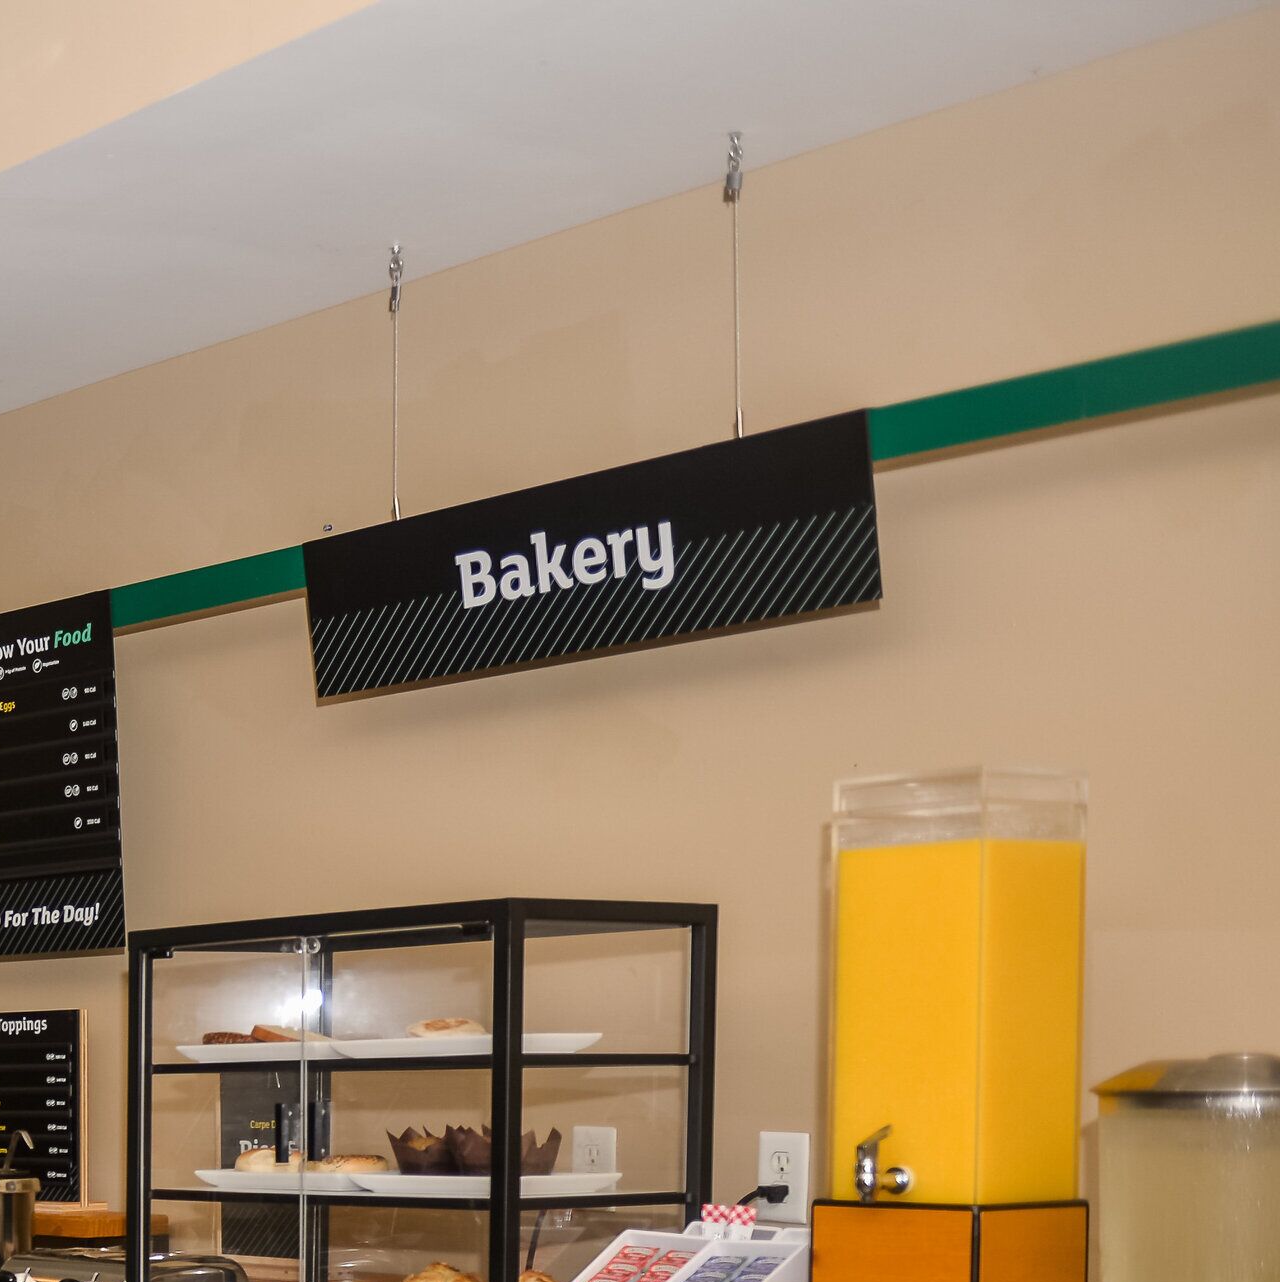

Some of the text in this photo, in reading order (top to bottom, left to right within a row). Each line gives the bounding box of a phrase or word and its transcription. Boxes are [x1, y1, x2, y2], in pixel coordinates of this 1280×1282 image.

[455, 521, 676, 609] Bakery
[17, 636, 50, 656] Your
[54, 622, 92, 648] Food
[0, 701, 16, 713] Eggs
[4, 910, 29, 928] For
[32, 905, 60, 926] The
[63, 902, 100, 926] Day!
[250, 1120, 270, 1130] Carpe
